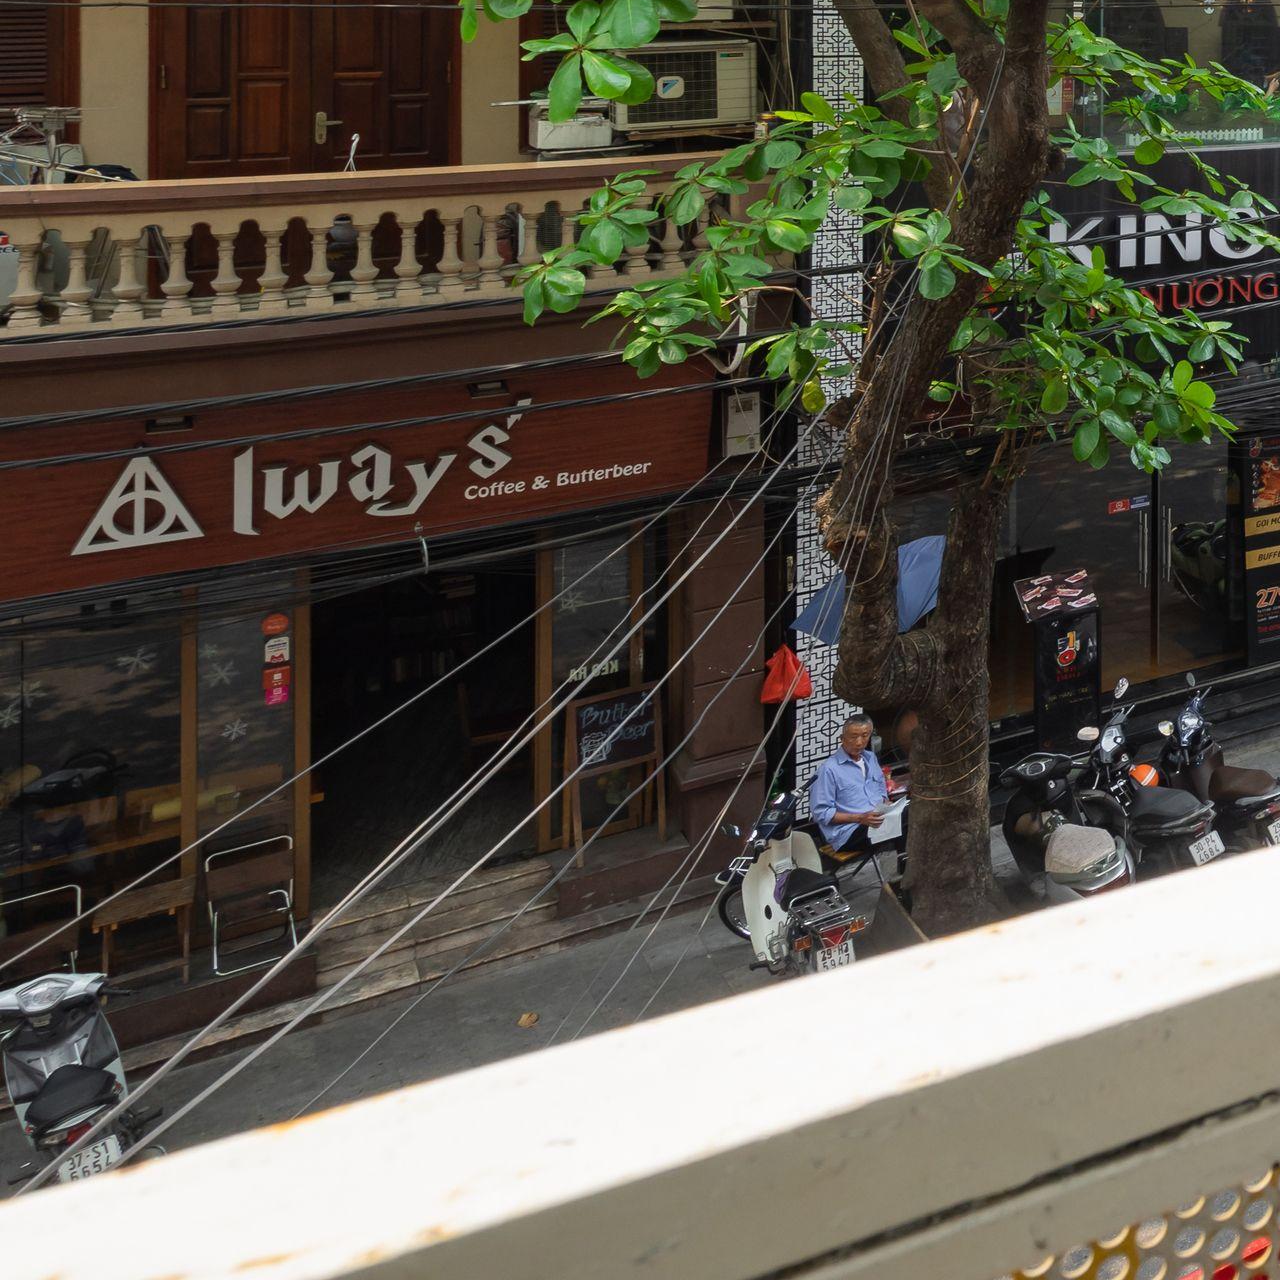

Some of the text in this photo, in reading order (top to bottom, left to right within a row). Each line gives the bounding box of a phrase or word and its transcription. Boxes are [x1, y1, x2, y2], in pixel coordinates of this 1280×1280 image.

[464, 462, 652, 500] Coffee & Butterbeer
[581, 701, 653, 729] Butter
